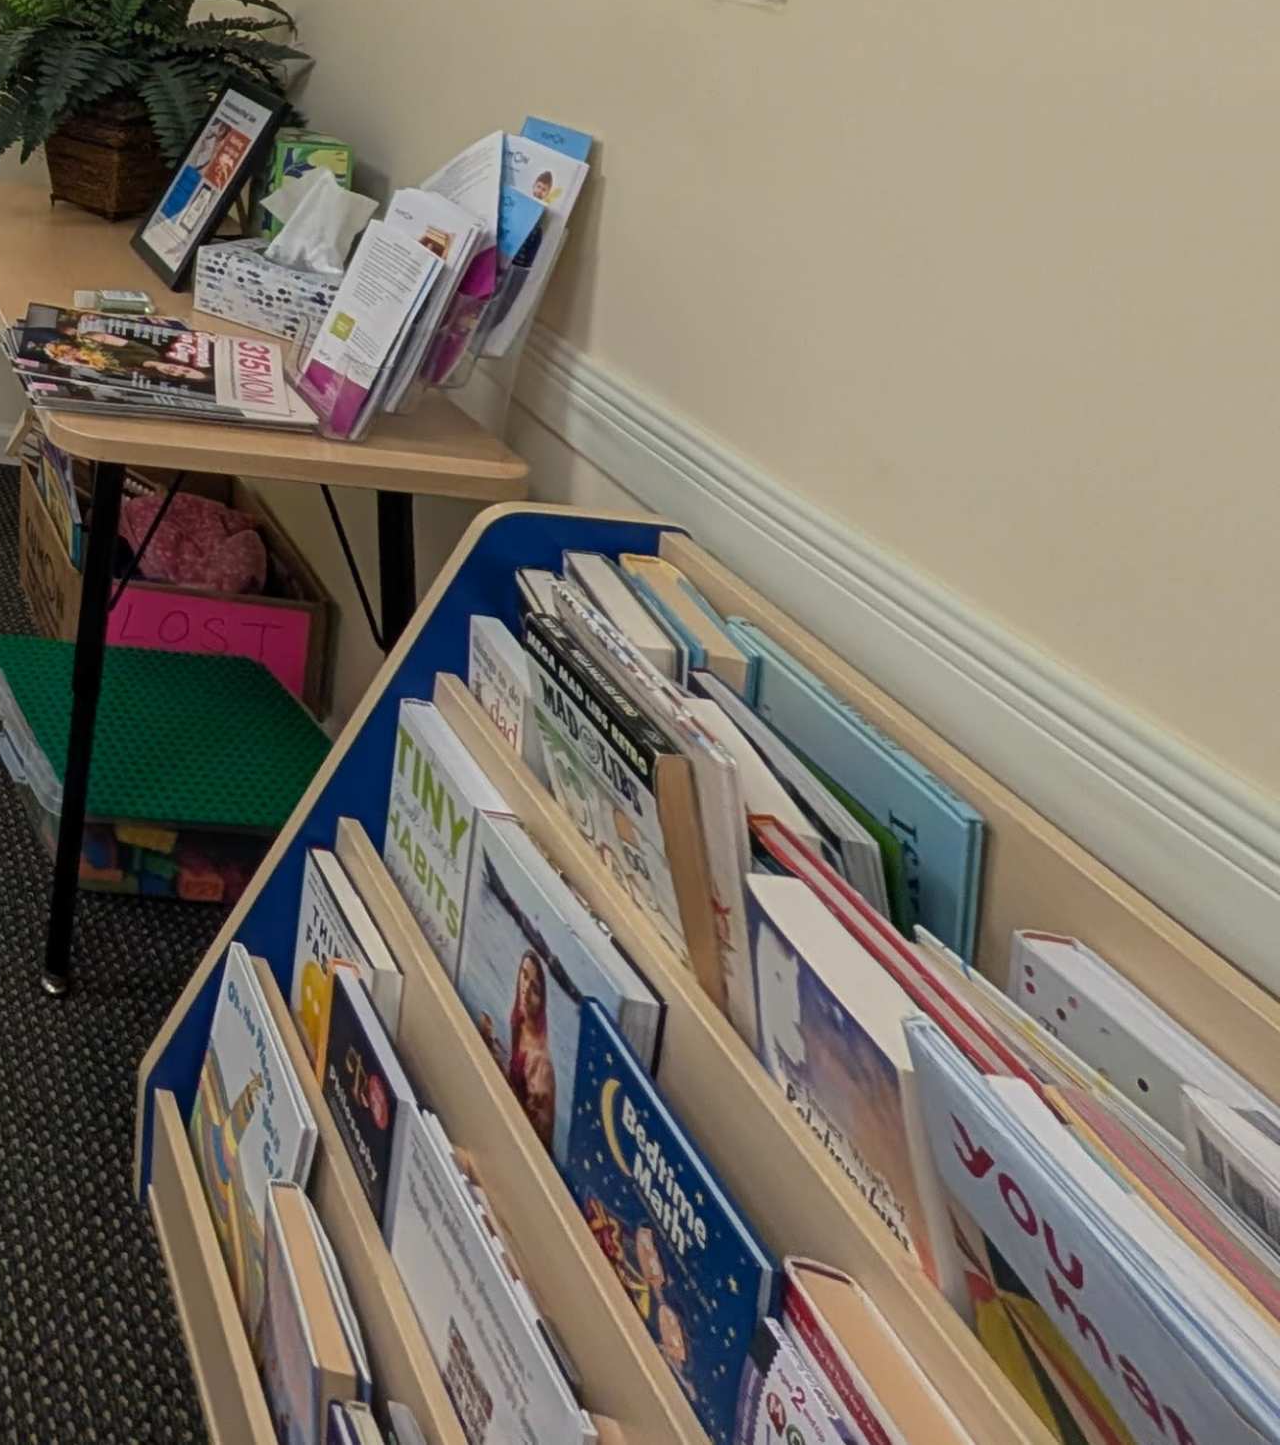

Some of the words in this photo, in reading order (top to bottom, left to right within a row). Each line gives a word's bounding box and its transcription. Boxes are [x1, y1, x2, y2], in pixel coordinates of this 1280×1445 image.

[119, 605, 286, 663] LOST
[526, 630, 556, 672] MEGA
[558, 665, 584, 701] MAD
[490, 697, 518, 751] dad
[539, 674, 580, 741] MAD
[398, 722, 470, 860] TINY
[390, 808, 460, 940] HABITS
[621, 1094, 707, 1251] Bedtime
[632, 1151, 686, 1256] Math
[948, 1110, 1085, 1290] you
